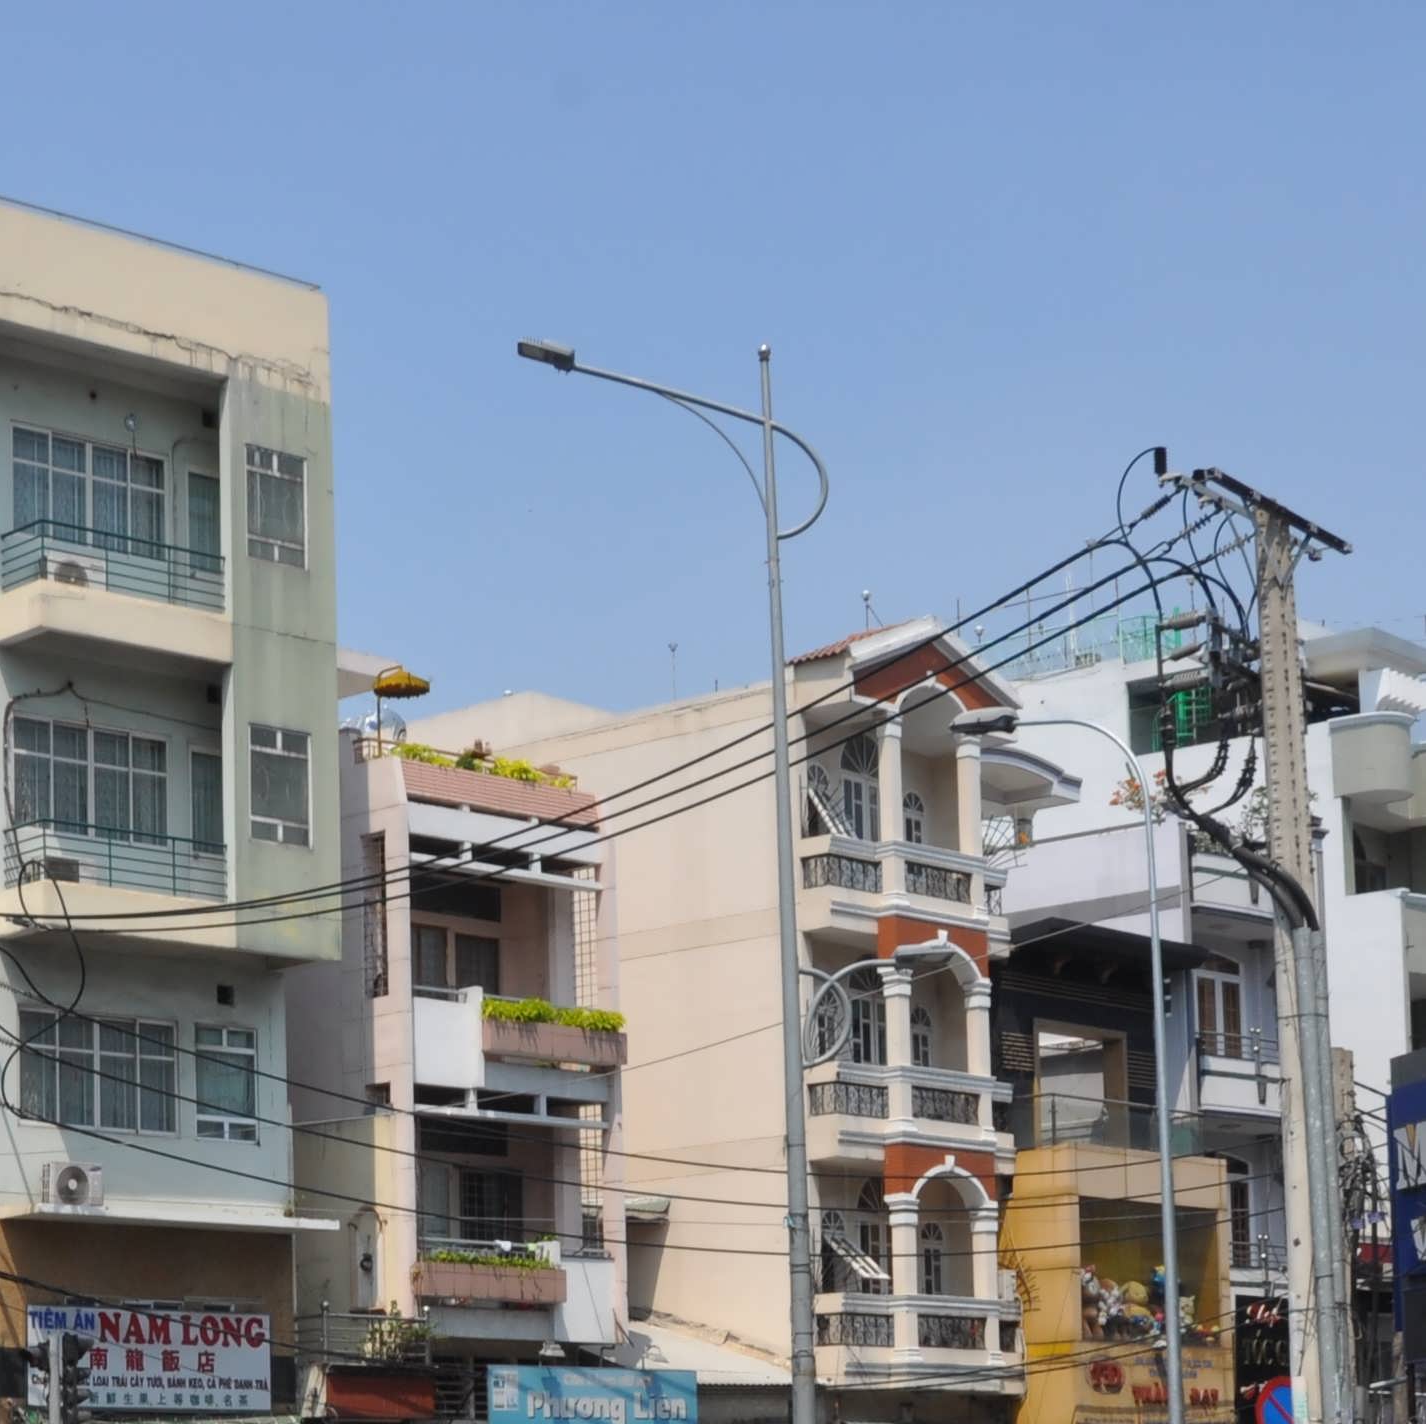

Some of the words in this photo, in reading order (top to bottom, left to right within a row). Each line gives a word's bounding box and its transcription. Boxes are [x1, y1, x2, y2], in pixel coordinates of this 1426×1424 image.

[29, 1307, 67, 1334] TIỆM
[74, 1308, 95, 1330] ĂN
[98, 1311, 172, 1345] NAM
[180, 1314, 266, 1349] LONG
[634, 1391, 687, 1420] Liên
